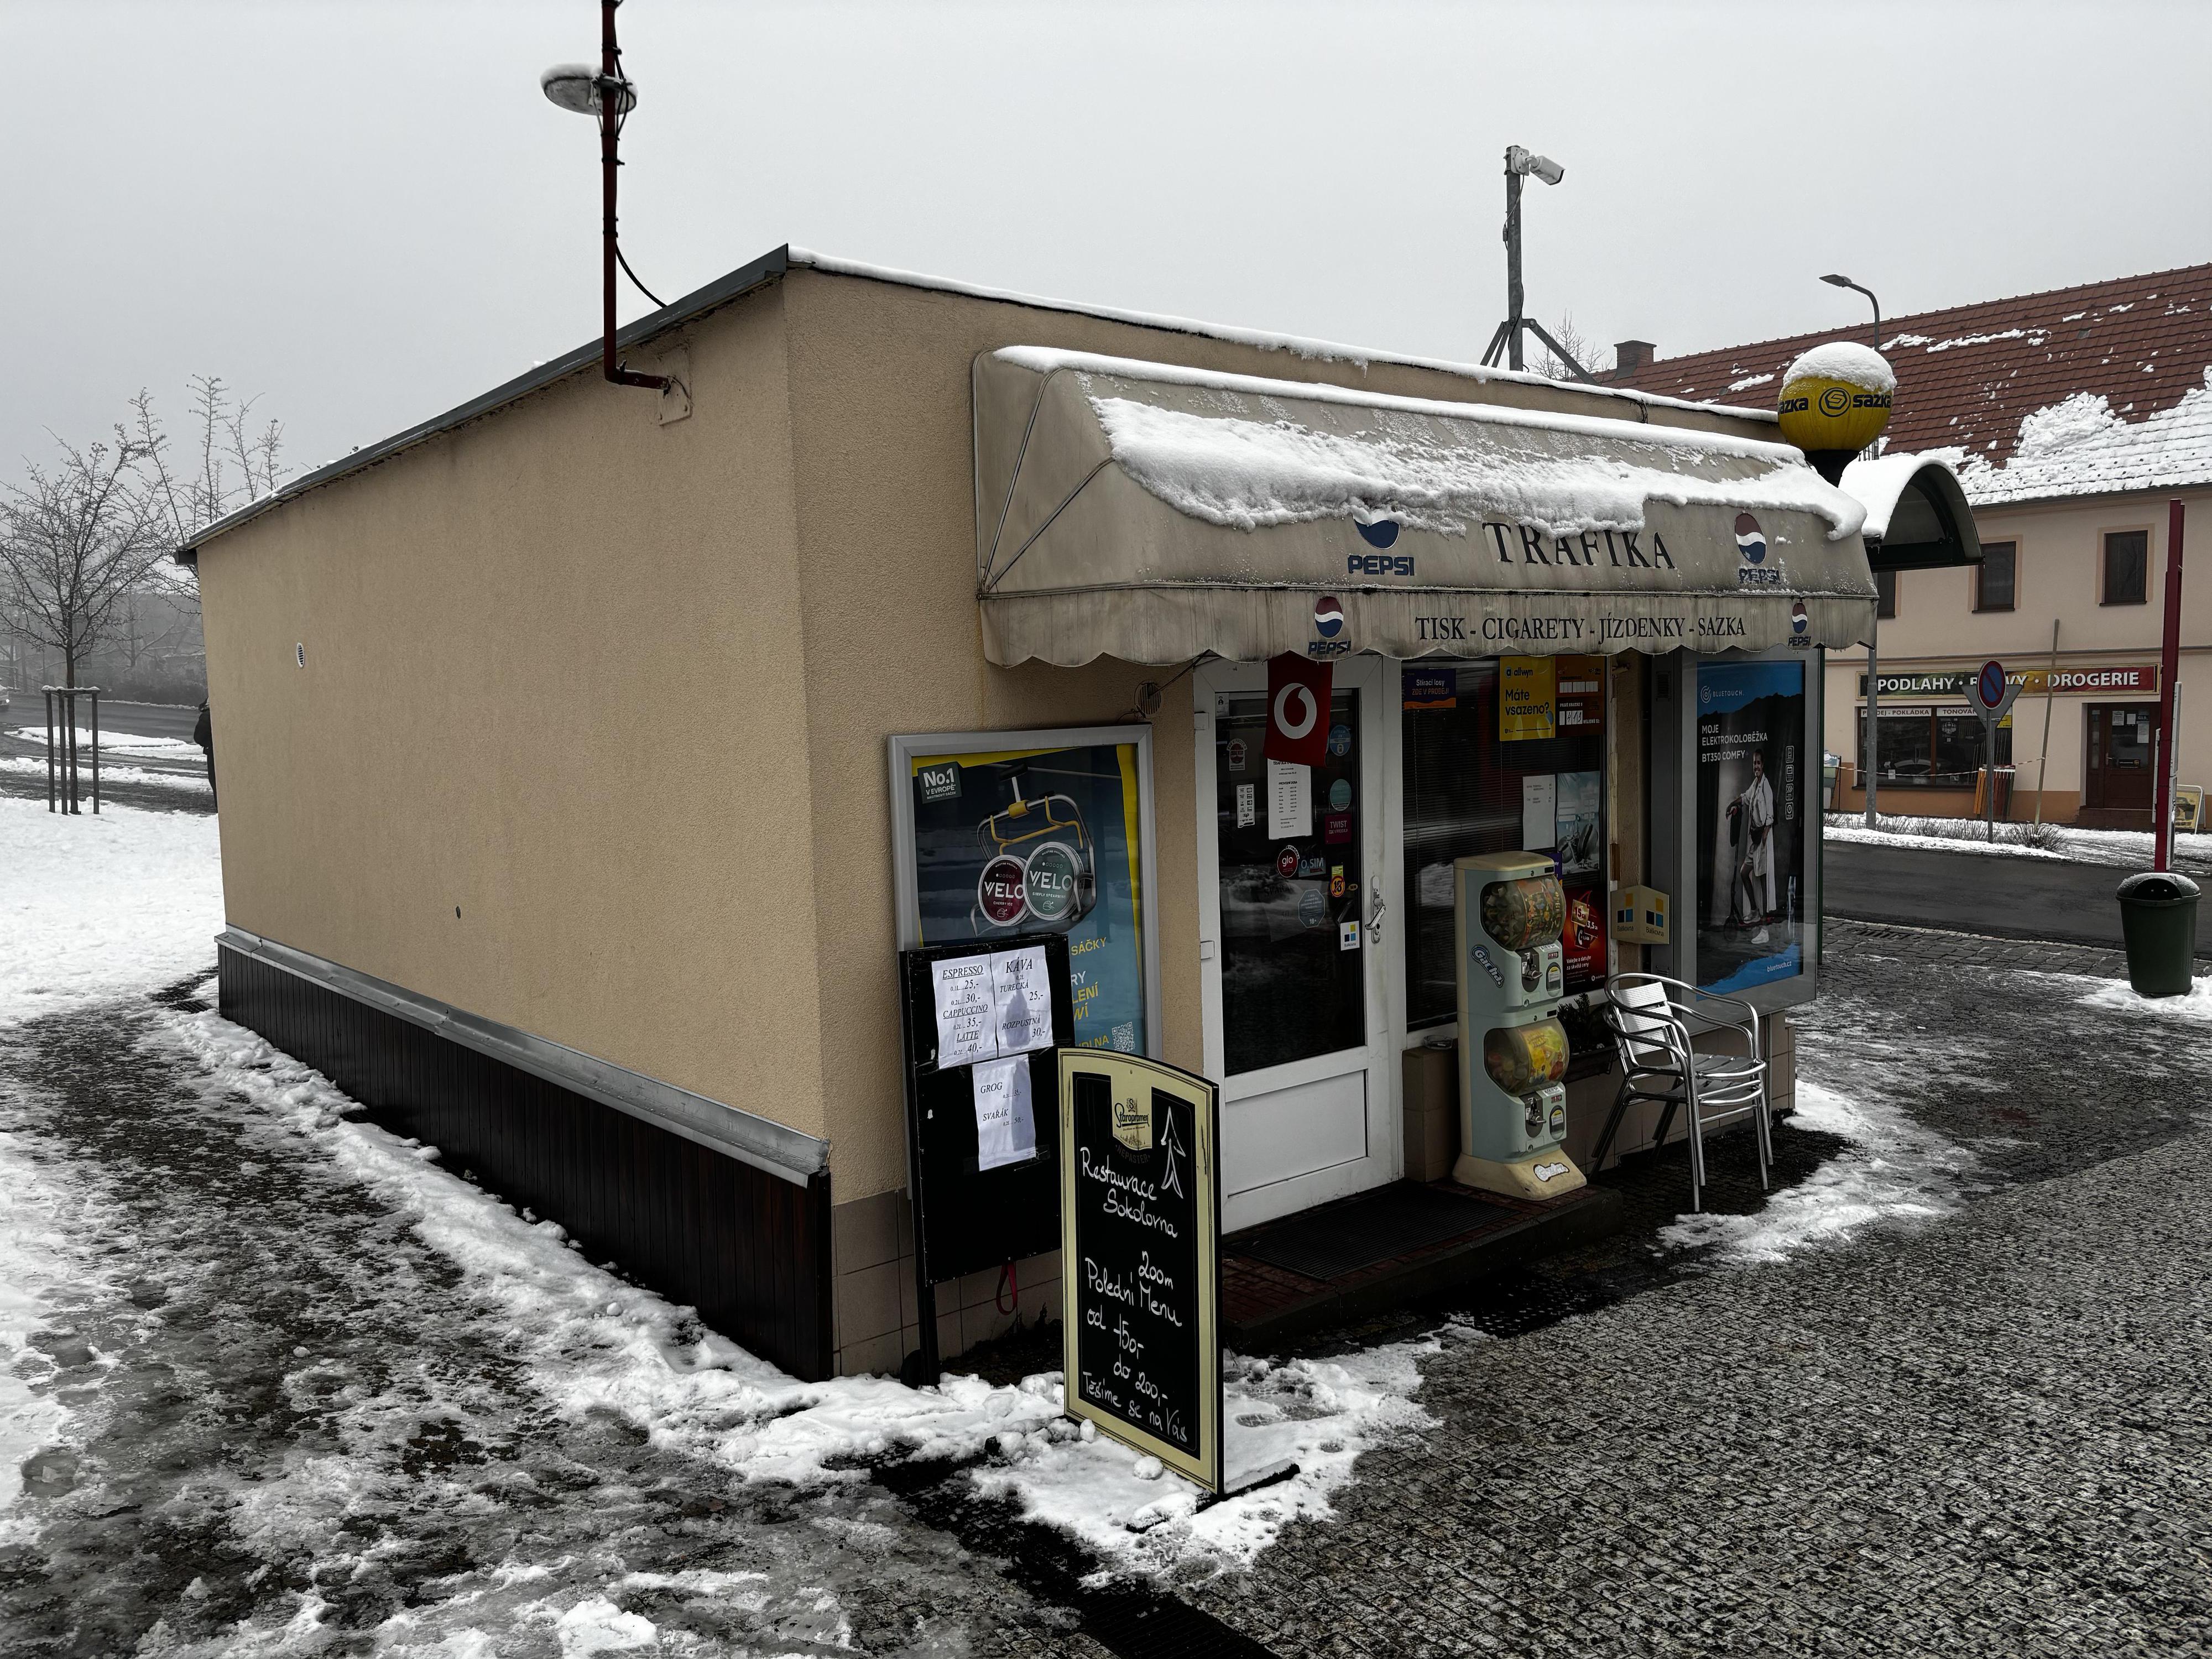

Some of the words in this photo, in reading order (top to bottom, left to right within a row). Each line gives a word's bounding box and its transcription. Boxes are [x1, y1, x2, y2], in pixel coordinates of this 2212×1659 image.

[1482, 523, 1676, 569] TRAFIKA
[1348, 555, 1415, 576] PEPSI
[1739, 568, 1781, 584] PEPSI
[1415, 617, 1465, 640] TISK
[1482, 618, 1585, 640] CIGARETY
[1598, 612, 1686, 645] JÍZDENKY
[1698, 617, 1746, 636] SAZKA
[1308, 641, 1351, 655] PEPSI
[1788, 637, 1811, 646] PEPSI
[1514, 667, 1533, 679] allwyn
[2048, 672, 2139, 687] DROGERIE
[1434, 679, 1445, 687] losy
[1878, 678, 1955, 691] PODLAHY
[1505, 688, 1530, 702] Máte
[1505, 702, 1550, 716] vsazeno?
[1702, 724, 1719, 734] MOJE
[1702, 731, 1768, 746] ELEKTROKOLOBĚŽKA
[1702, 752, 1720, 763] BT350
[1722, 750, 1745, 760] COMFY
[1329, 820, 1347, 829] TWIST
[1282, 855, 1293, 867] glo
[1030, 870, 1073, 891] VELO
[984, 881, 1024, 899] VELO
[1071, 937, 1107, 956] SÁČKY
[943, 965, 983, 979] ESPRESSO
[1005, 957, 1032, 973] KÁVA
[965, 979, 979, 990] 25,-
[1000, 979, 1029, 993] TURECKÁ
[966, 993, 980, 1003] 30,-
[1029, 991, 1044, 1001] 25,-
[943, 1004, 988, 1018] CAPPUCCINO
[967, 1018, 982, 1028] 35,-
[1002, 1014, 1040, 1030] ROZPUSTNÁ
[957, 1030, 979, 1042] LATTE
[1032, 1027, 1045, 1037] 30,-
[980, 1082, 1003, 1094] GROG
[983, 1108, 1008, 1121] SVAŘÁK
[1115, 1102, 1150, 1128] Staropramen
[1080, 1146, 1157, 1201] Restaurace
[1103, 1188, 1178, 1238] Sokolovna
[1140, 1281, 1182, 1327] Menu
[1087, 1305, 1106, 1330] od
[1114, 1354, 1131, 1379] do
[1129, 1400, 1142, 1418] se
[1149, 1411, 1163, 1431] na
